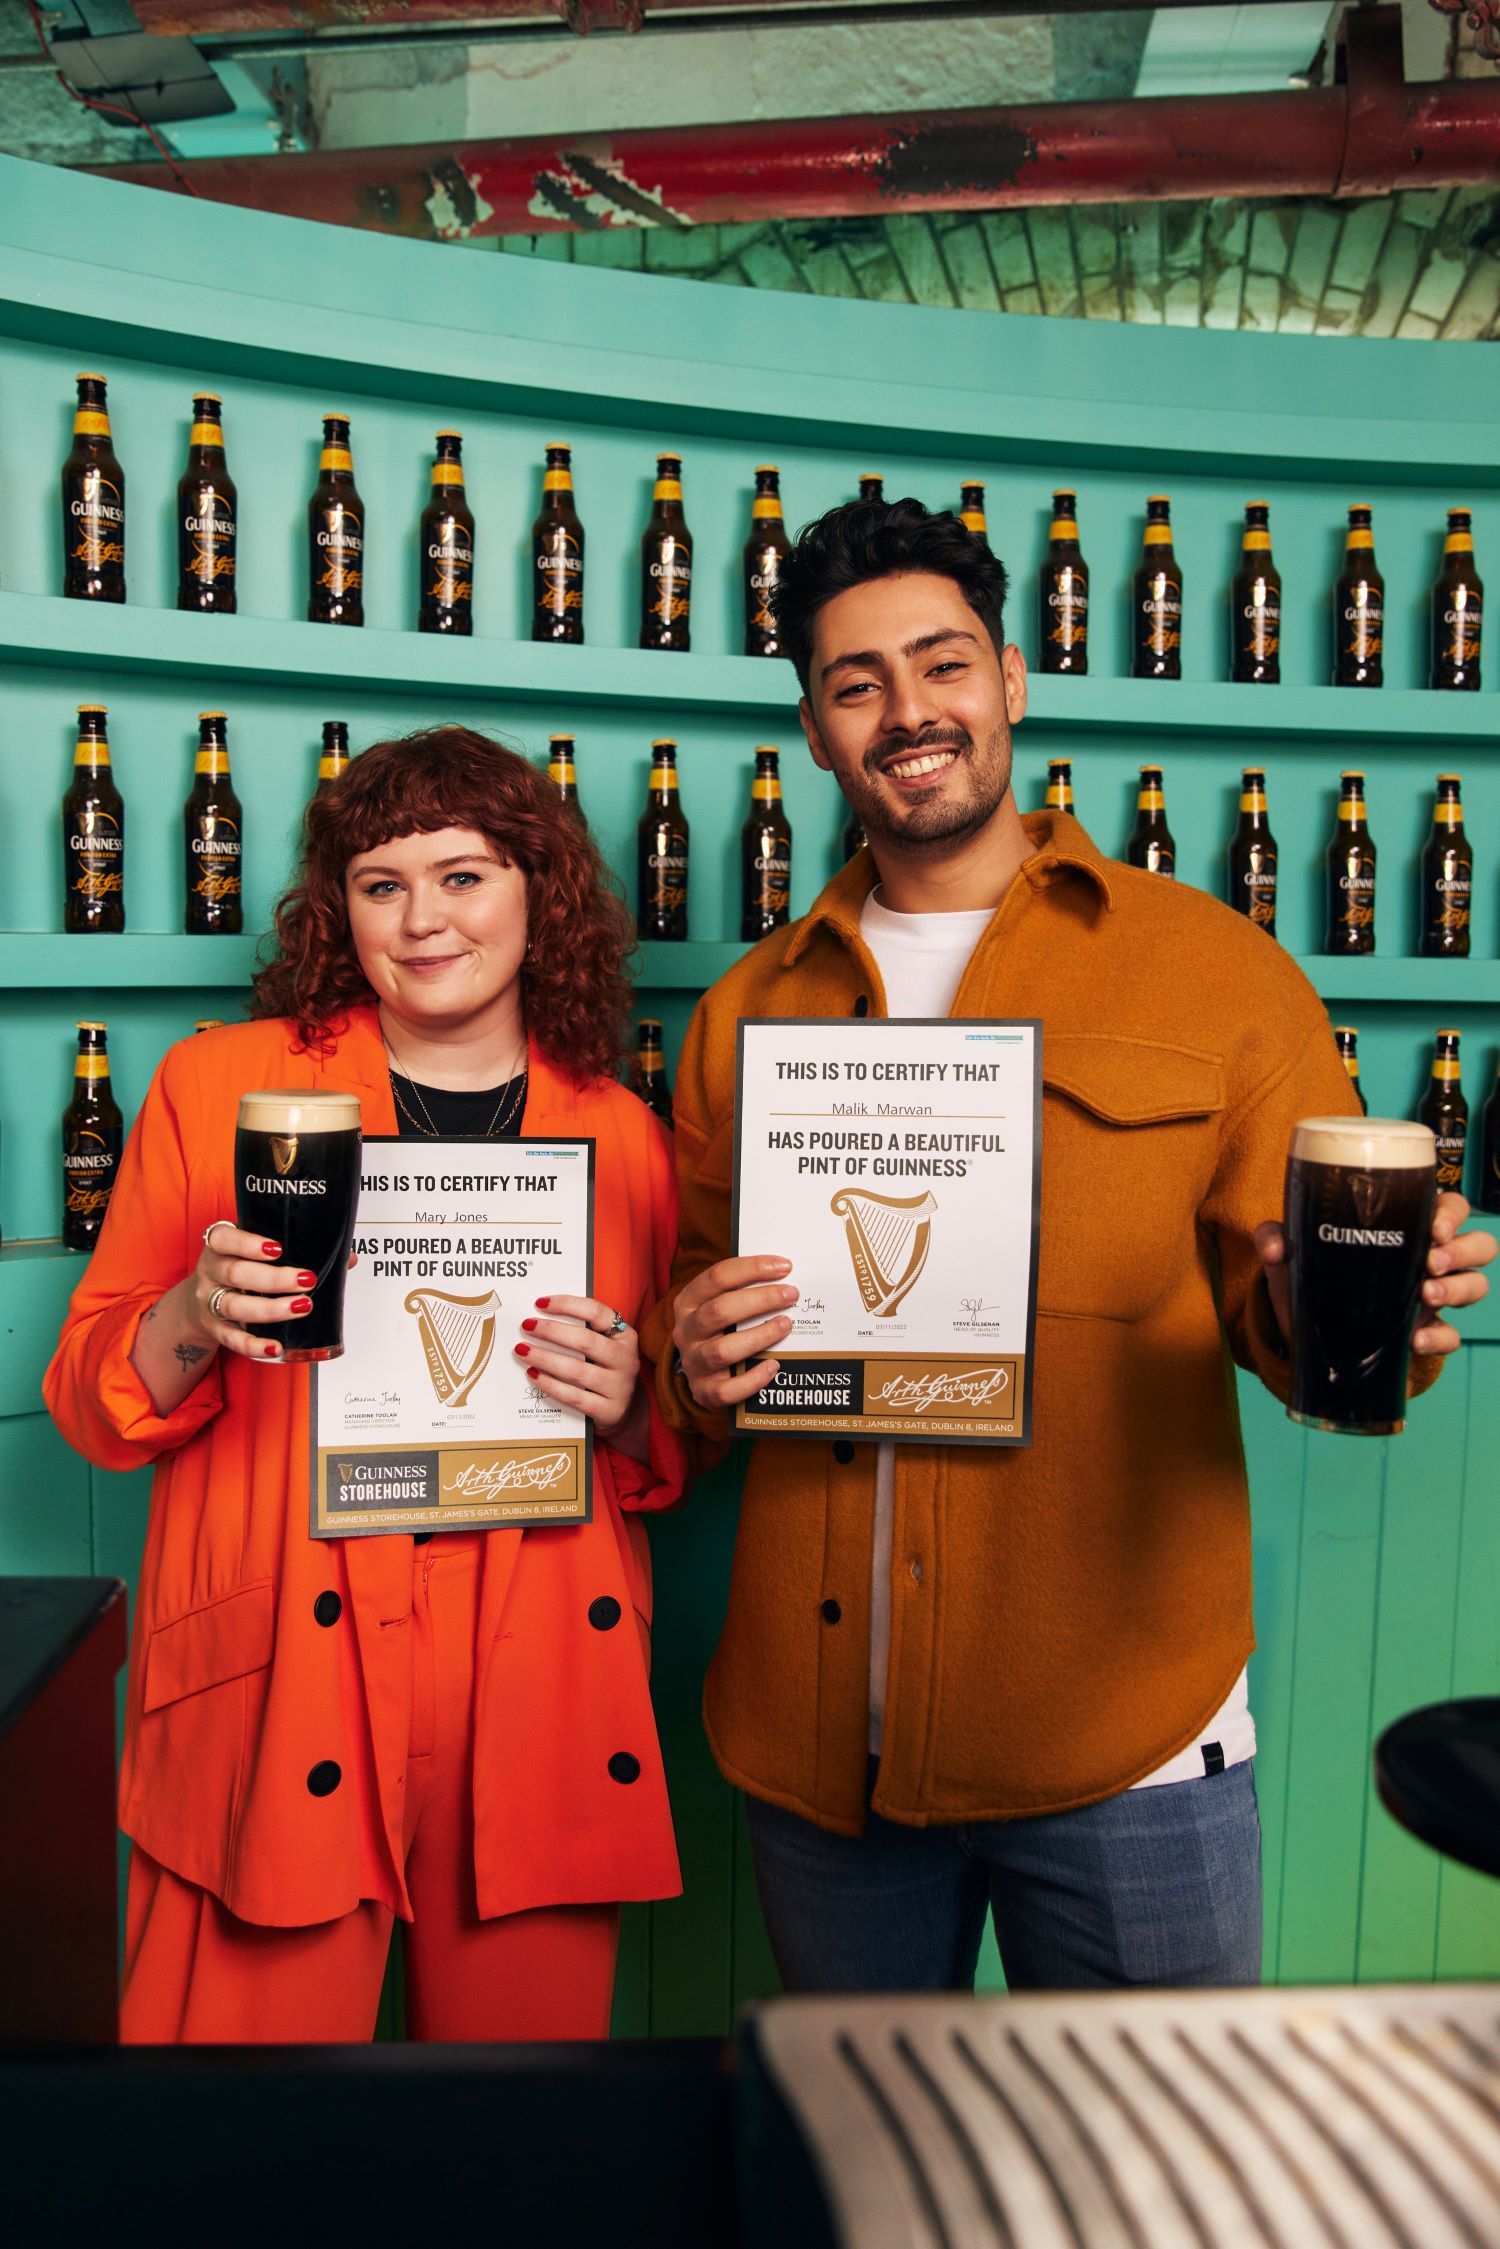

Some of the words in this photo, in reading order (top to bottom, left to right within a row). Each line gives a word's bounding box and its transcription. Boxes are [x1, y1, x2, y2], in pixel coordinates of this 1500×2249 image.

[776, 1062, 817, 1080] THIS
[822, 1062, 839, 1080] IS
[844, 1063, 867, 1080] TO
[872, 1063, 948, 1081] CERTIFY
[953, 1064, 1000, 1081] THAT
[832, 1103, 868, 1115] Malik
[877, 1103, 932, 1116] Marwan
[768, 1131, 804, 1149] HAS
[809, 1132, 882, 1150] POURED
[888, 1133, 900, 1151] A
[904, 1134, 1005, 1152] BEAUTIFUL
[798, 1157, 840, 1174] PINT
[845, 1157, 868, 1175] OF
[246, 1174, 327, 1195] GUINNESS
[360, 1175, 389, 1191] HIS
[394, 1175, 410, 1191] IS
[414, 1175, 436, 1191] TO
[440, 1175, 510, 1191] CERTIFY
[514, 1175, 557, 1191] THAT
[415, 1211, 446, 1224] Mary
[454, 1211, 488, 1223] Jones
[1318, 1223, 1404, 1247] GUINNESS
[384, 1238, 451, 1254] POURED
[456, 1238, 467, 1254] A
[472, 1238, 562, 1255] BEAUTIFUL
[373, 1261, 412, 1277] PINT
[417, 1261, 438, 1277] OF
[860, 1277, 876, 1301] 1759
[432, 1368, 448, 1392] 1759
[775, 1372, 852, 1386] GUINNESS
[758, 1389, 851, 1405] STOREHOUSE
[744, 1417, 788, 1426] GUINNESS
[790, 1418, 850, 1427] STOREHOUSE,
[866, 1420, 902, 1428] JAMES'S
[904, 1421, 928, 1430] GATE,
[931, 1422, 964, 1430] DUBLIN
[975, 1423, 1014, 1432] IRELAND
[355, 1465, 427, 1480] GUINNESS
[340, 1482, 427, 1501] STOREHOUSE
[326, 1515, 368, 1524] GUINNESS
[370, 1512, 427, 1522] STOREHOUSE,
[429, 1511, 440, 1519] ST.
[442, 1509, 475, 1518] JAMES'S
[477, 1508, 500, 1517] GATE,
[502, 1507, 531, 1515] DUBLIN
[542, 1505, 578, 1513] IRELAND
